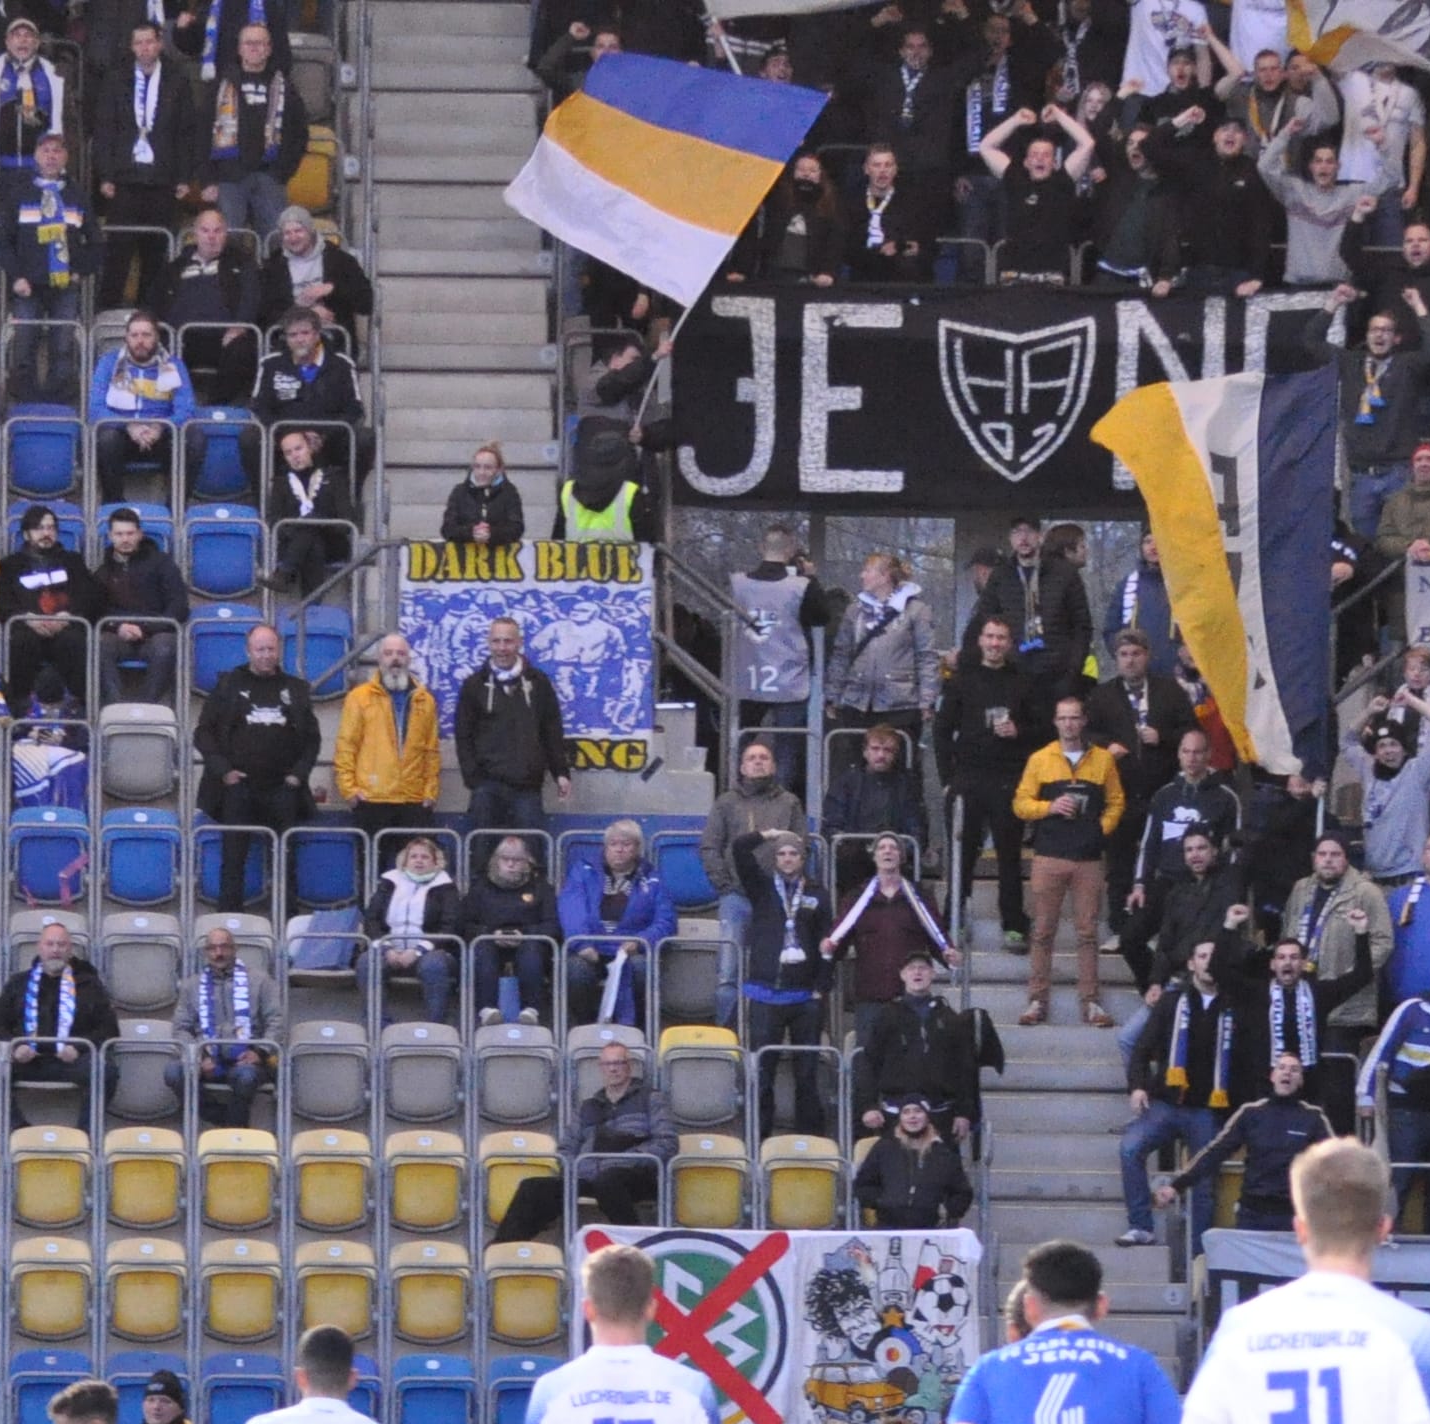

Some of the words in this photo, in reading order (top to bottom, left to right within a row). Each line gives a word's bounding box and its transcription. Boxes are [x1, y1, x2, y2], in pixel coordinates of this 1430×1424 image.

[408, 540, 523, 582] DARK
[534, 540, 643, 583] BLUE
[746, 665, 779, 693] 12
[1021, 1348, 1102, 1366] JENA
